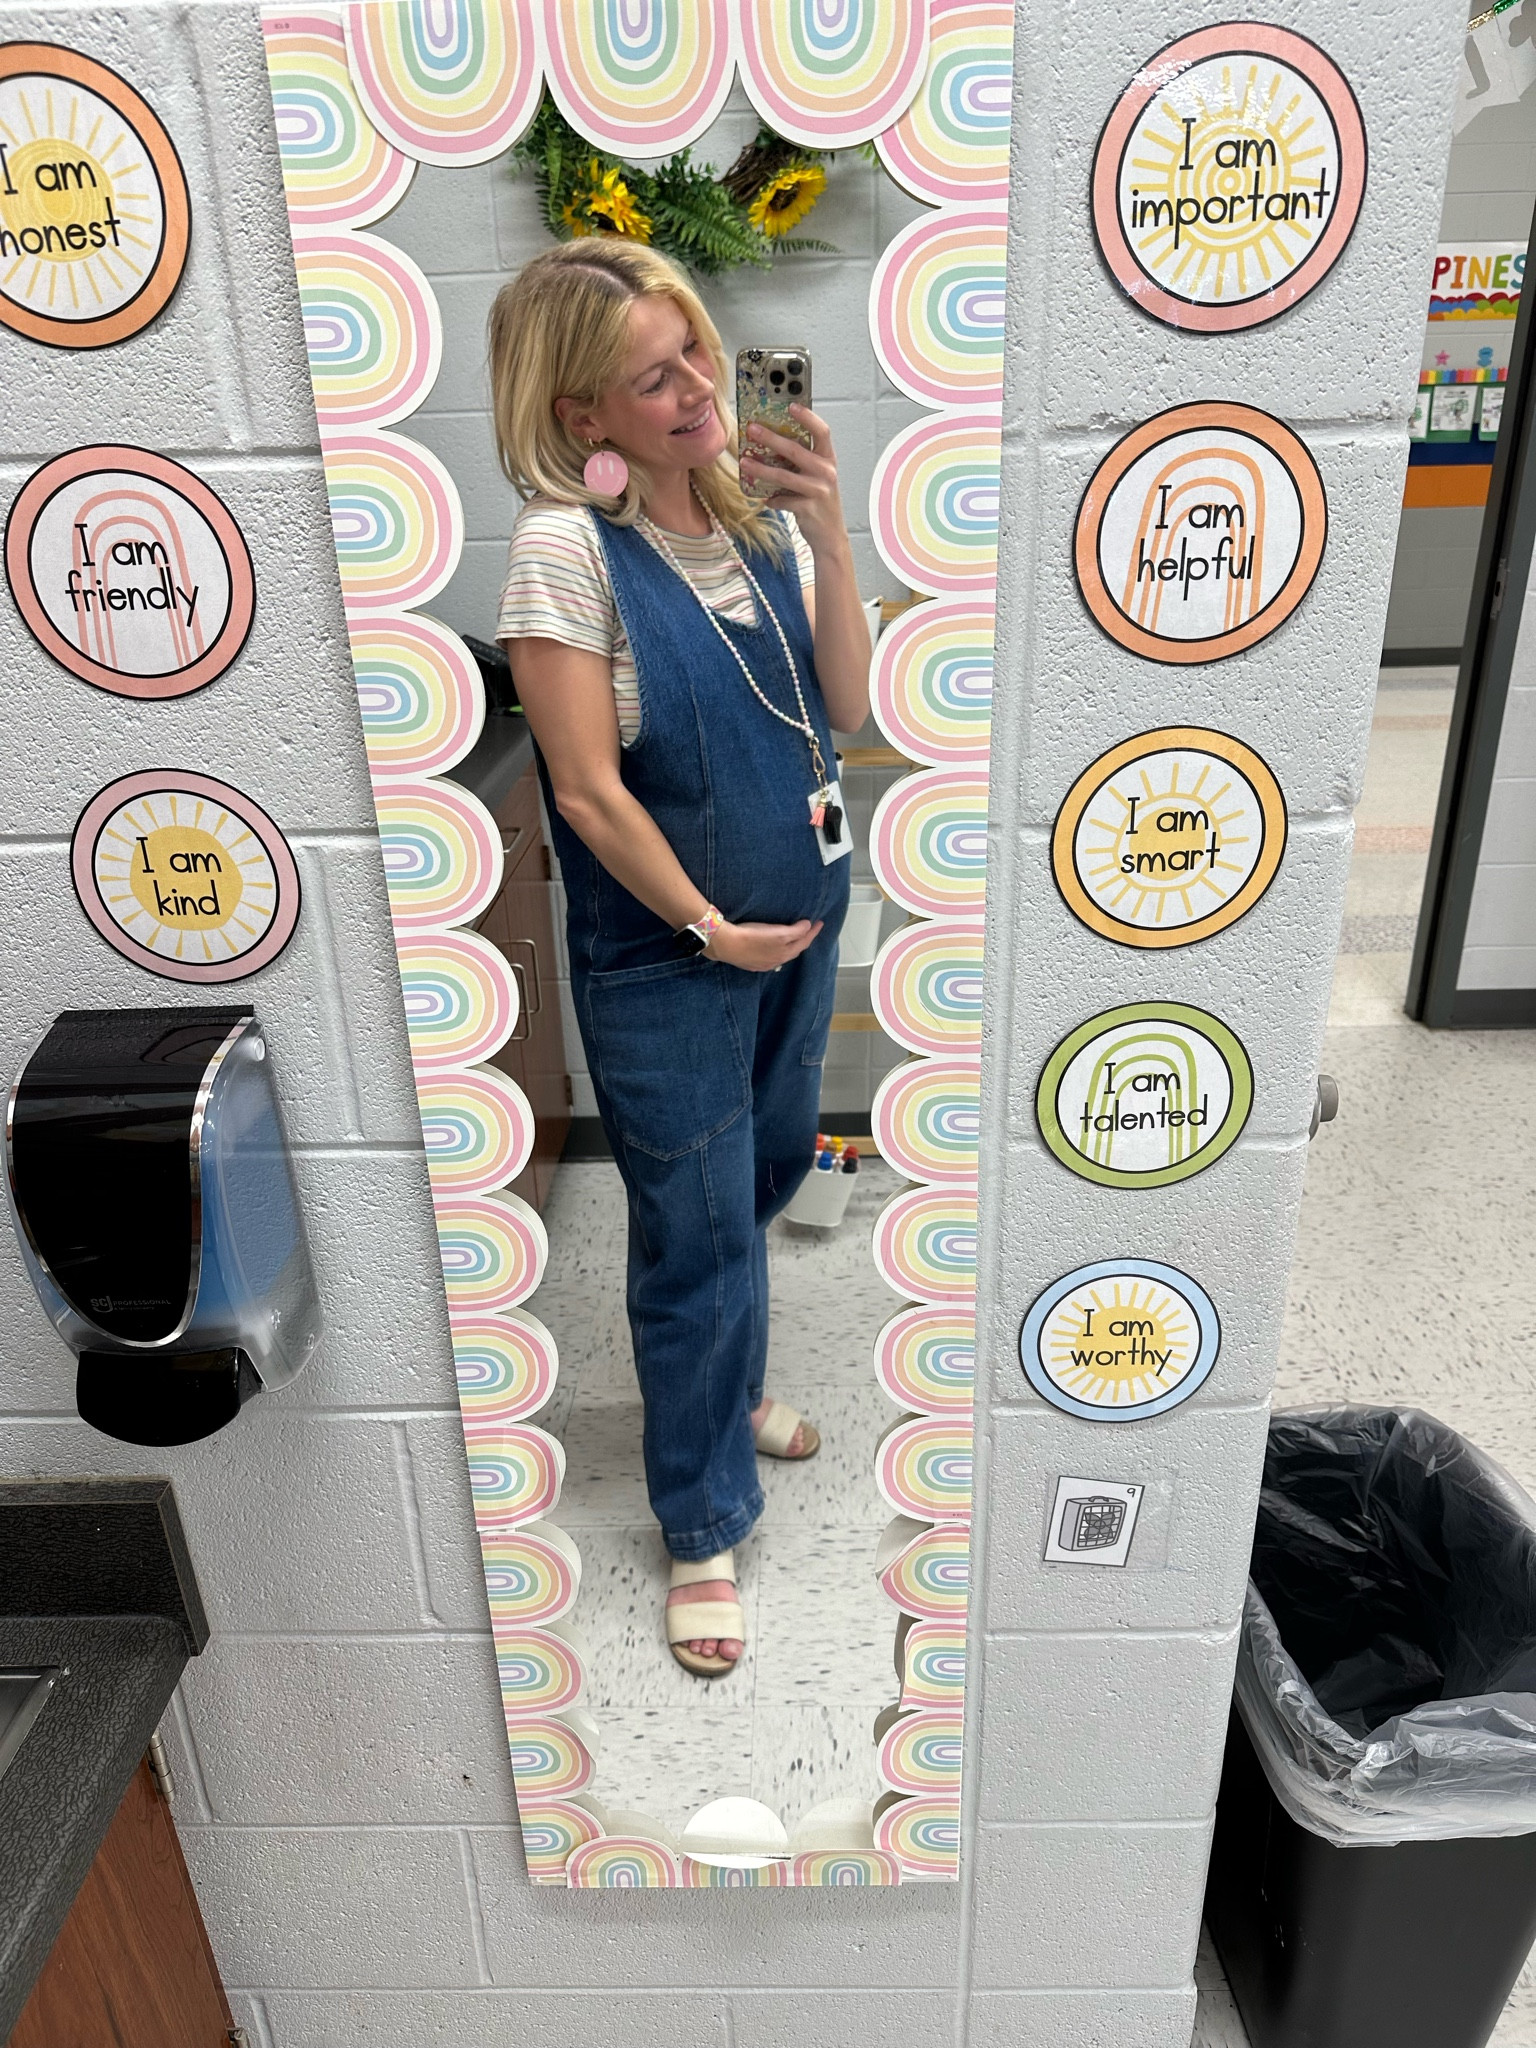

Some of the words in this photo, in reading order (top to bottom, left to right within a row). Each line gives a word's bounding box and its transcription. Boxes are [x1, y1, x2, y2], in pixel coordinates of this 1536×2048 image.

[1180, 118, 1196, 170] I
[1216, 138, 1276, 169] am
[0, 144, 17, 194] I
[36, 161, 96, 191] am
[1131, 168, 1331, 250] important
[1431, 254, 1527, 290] PINES
[1155, 485, 1171, 529] I
[1189, 505, 1244, 528] am
[75, 524, 95, 566] I
[112, 542, 168, 565] am
[1138, 536, 1255, 600] helpful
[65, 567, 199, 627] friendly
[1126, 797, 1140, 834] I
[1157, 811, 1208, 832] am
[136, 837, 154, 873] I
[170, 853, 222, 873] am
[1121, 832, 1220, 874] smart
[153, 880, 220, 915] kind
[1104, 1063, 1116, 1094] I
[1132, 1073, 1180, 1092] am
[1080, 1094, 1208, 1133] talented
[1083, 1309, 1094, 1336] I
[1109, 1321, 1153, 1336] am
[1071, 1337, 1172, 1377] worthy
[1127, 1488, 1135, 1497] 9
